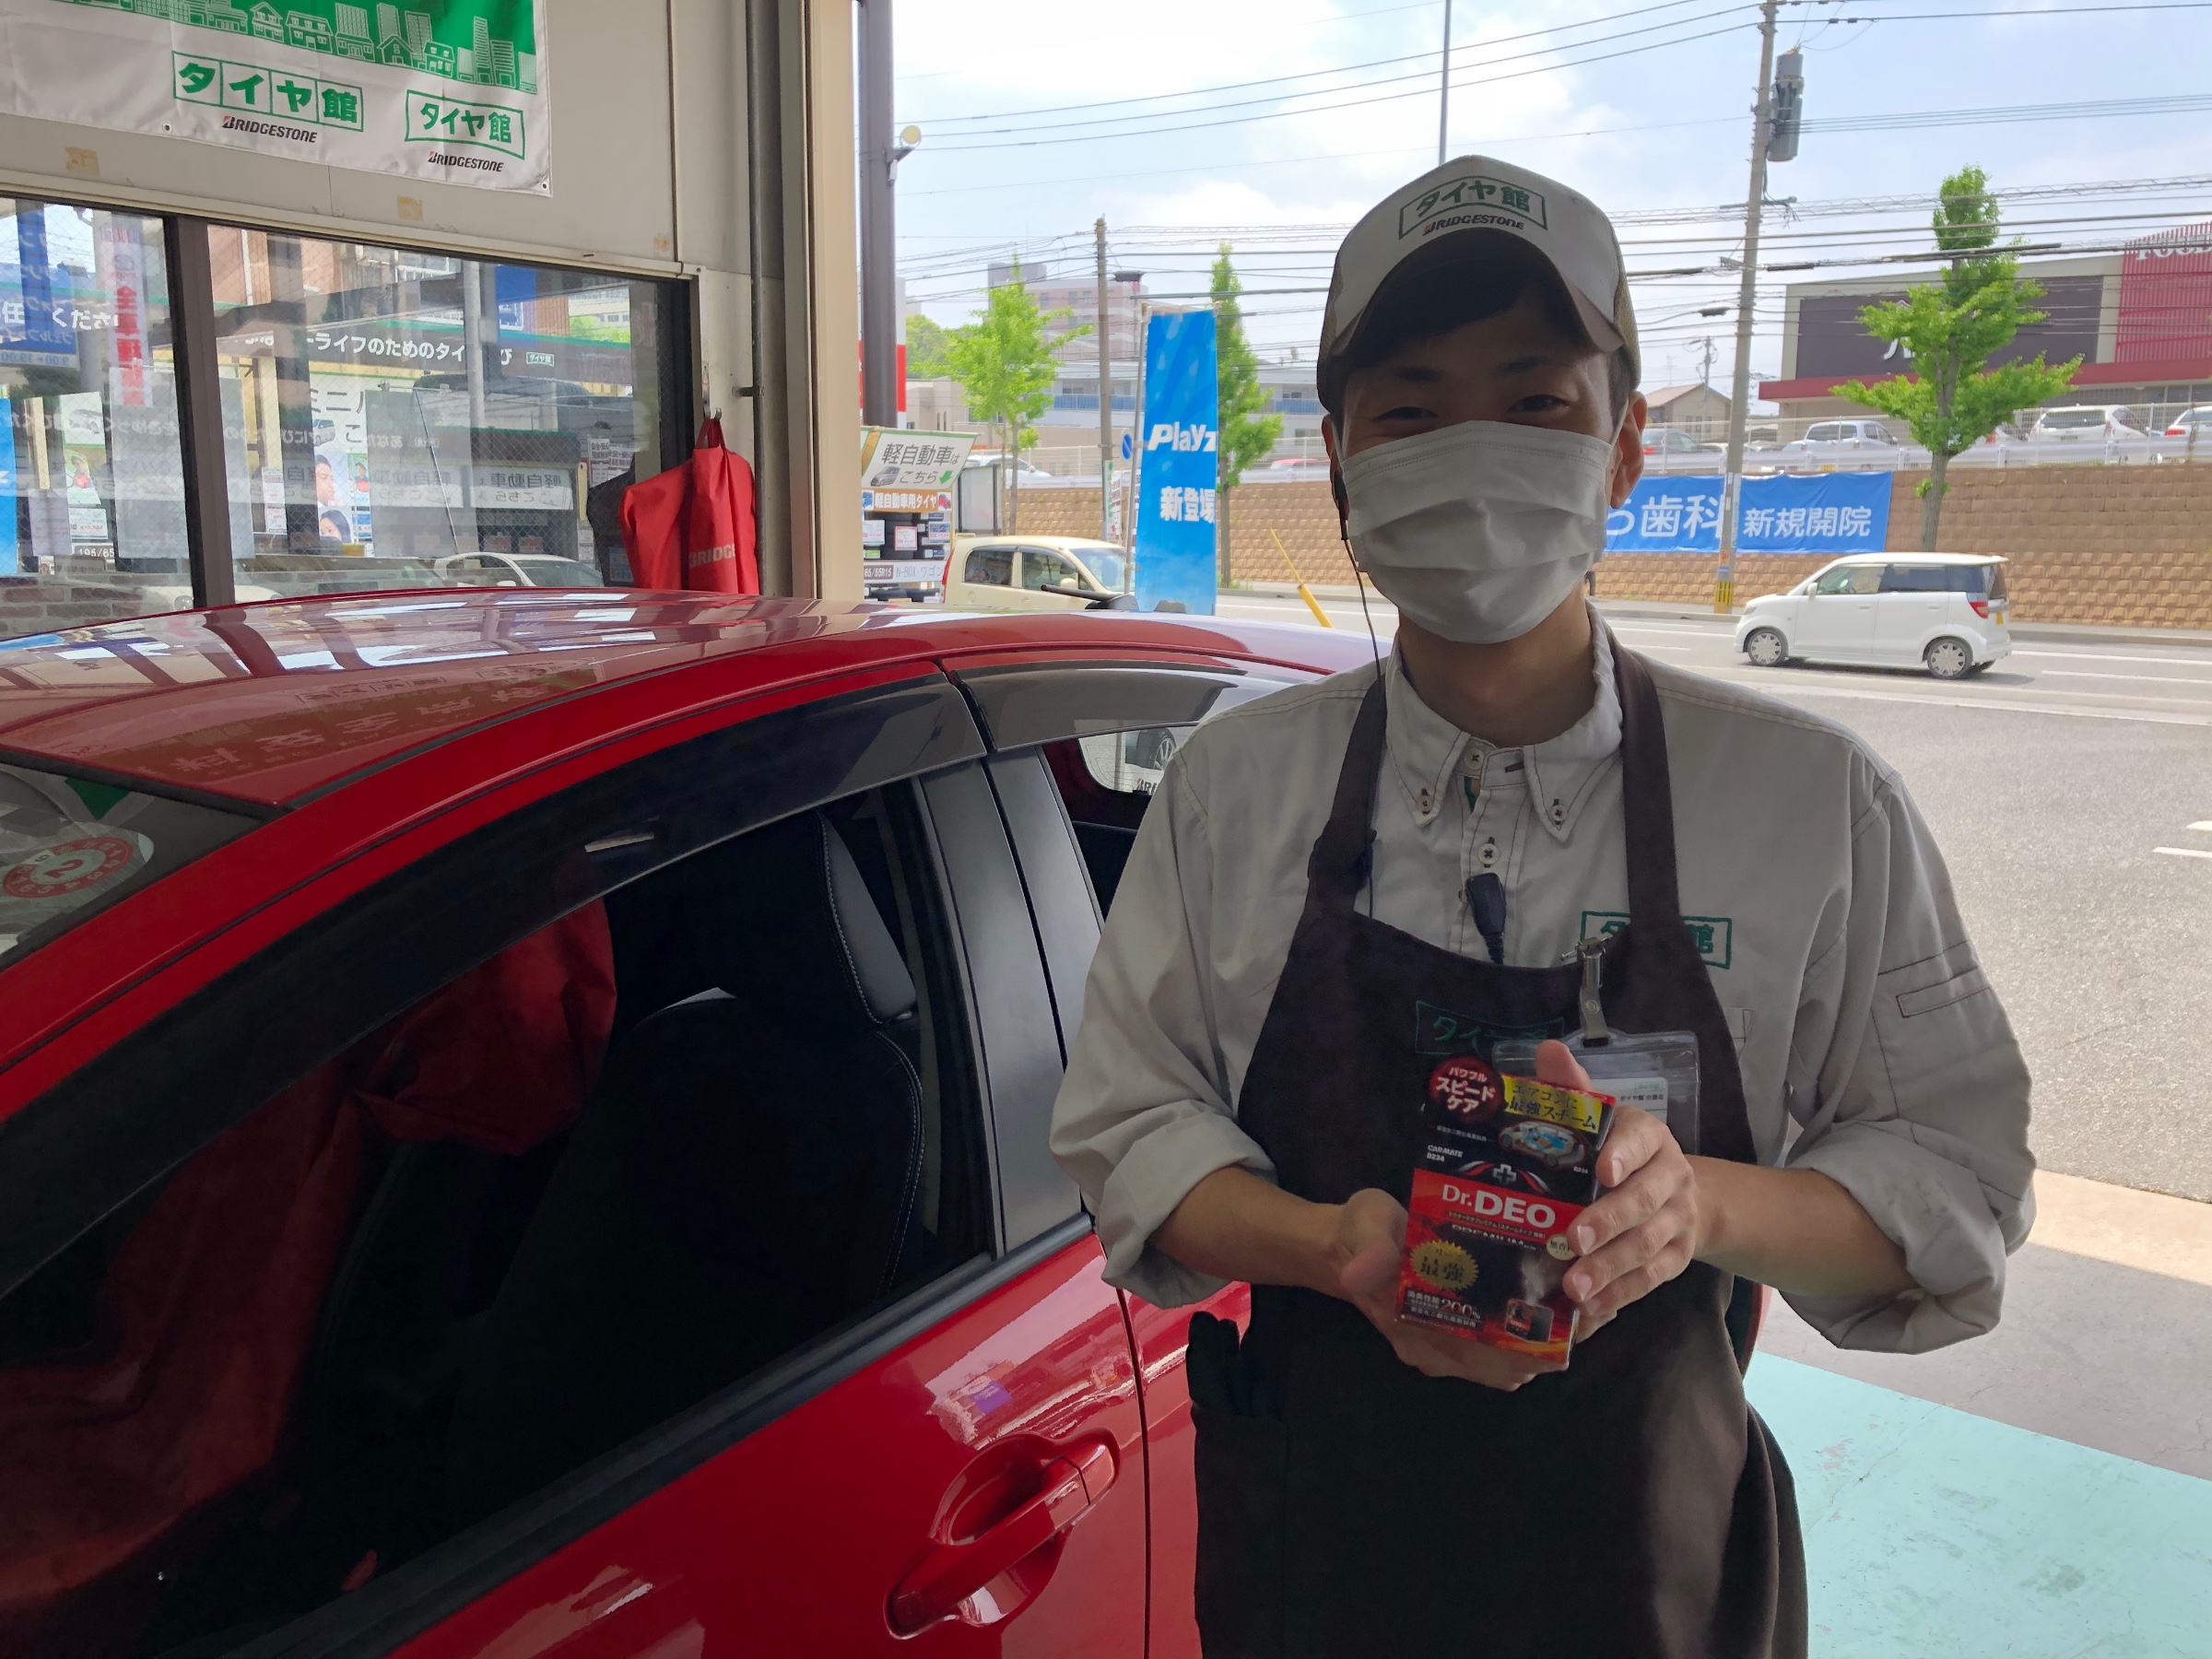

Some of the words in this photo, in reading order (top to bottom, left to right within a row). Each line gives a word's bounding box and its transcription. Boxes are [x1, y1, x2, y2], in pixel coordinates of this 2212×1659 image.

[179, 63, 358, 123] タイヤ館
[222, 116, 318, 143] BRIDGESTONE
[420, 103, 512, 143] タイヤ館
[428, 151, 504, 172] BRIDGESTONE
[1417, 180, 1530, 217] タイヤ館
[1423, 214, 1524, 236] BRIDGESTONE
[900, 470, 938, 484] こちら
[1160, 486, 1215, 524] 新登場
[1743, 507, 1872, 538] 新規開院
[43, 858, 84, 879] 2
[1449, 1067, 1488, 1083] パワフル
[1436, 1077, 1496, 1101] スピード
[1447, 1095, 1479, 1113] ケア
